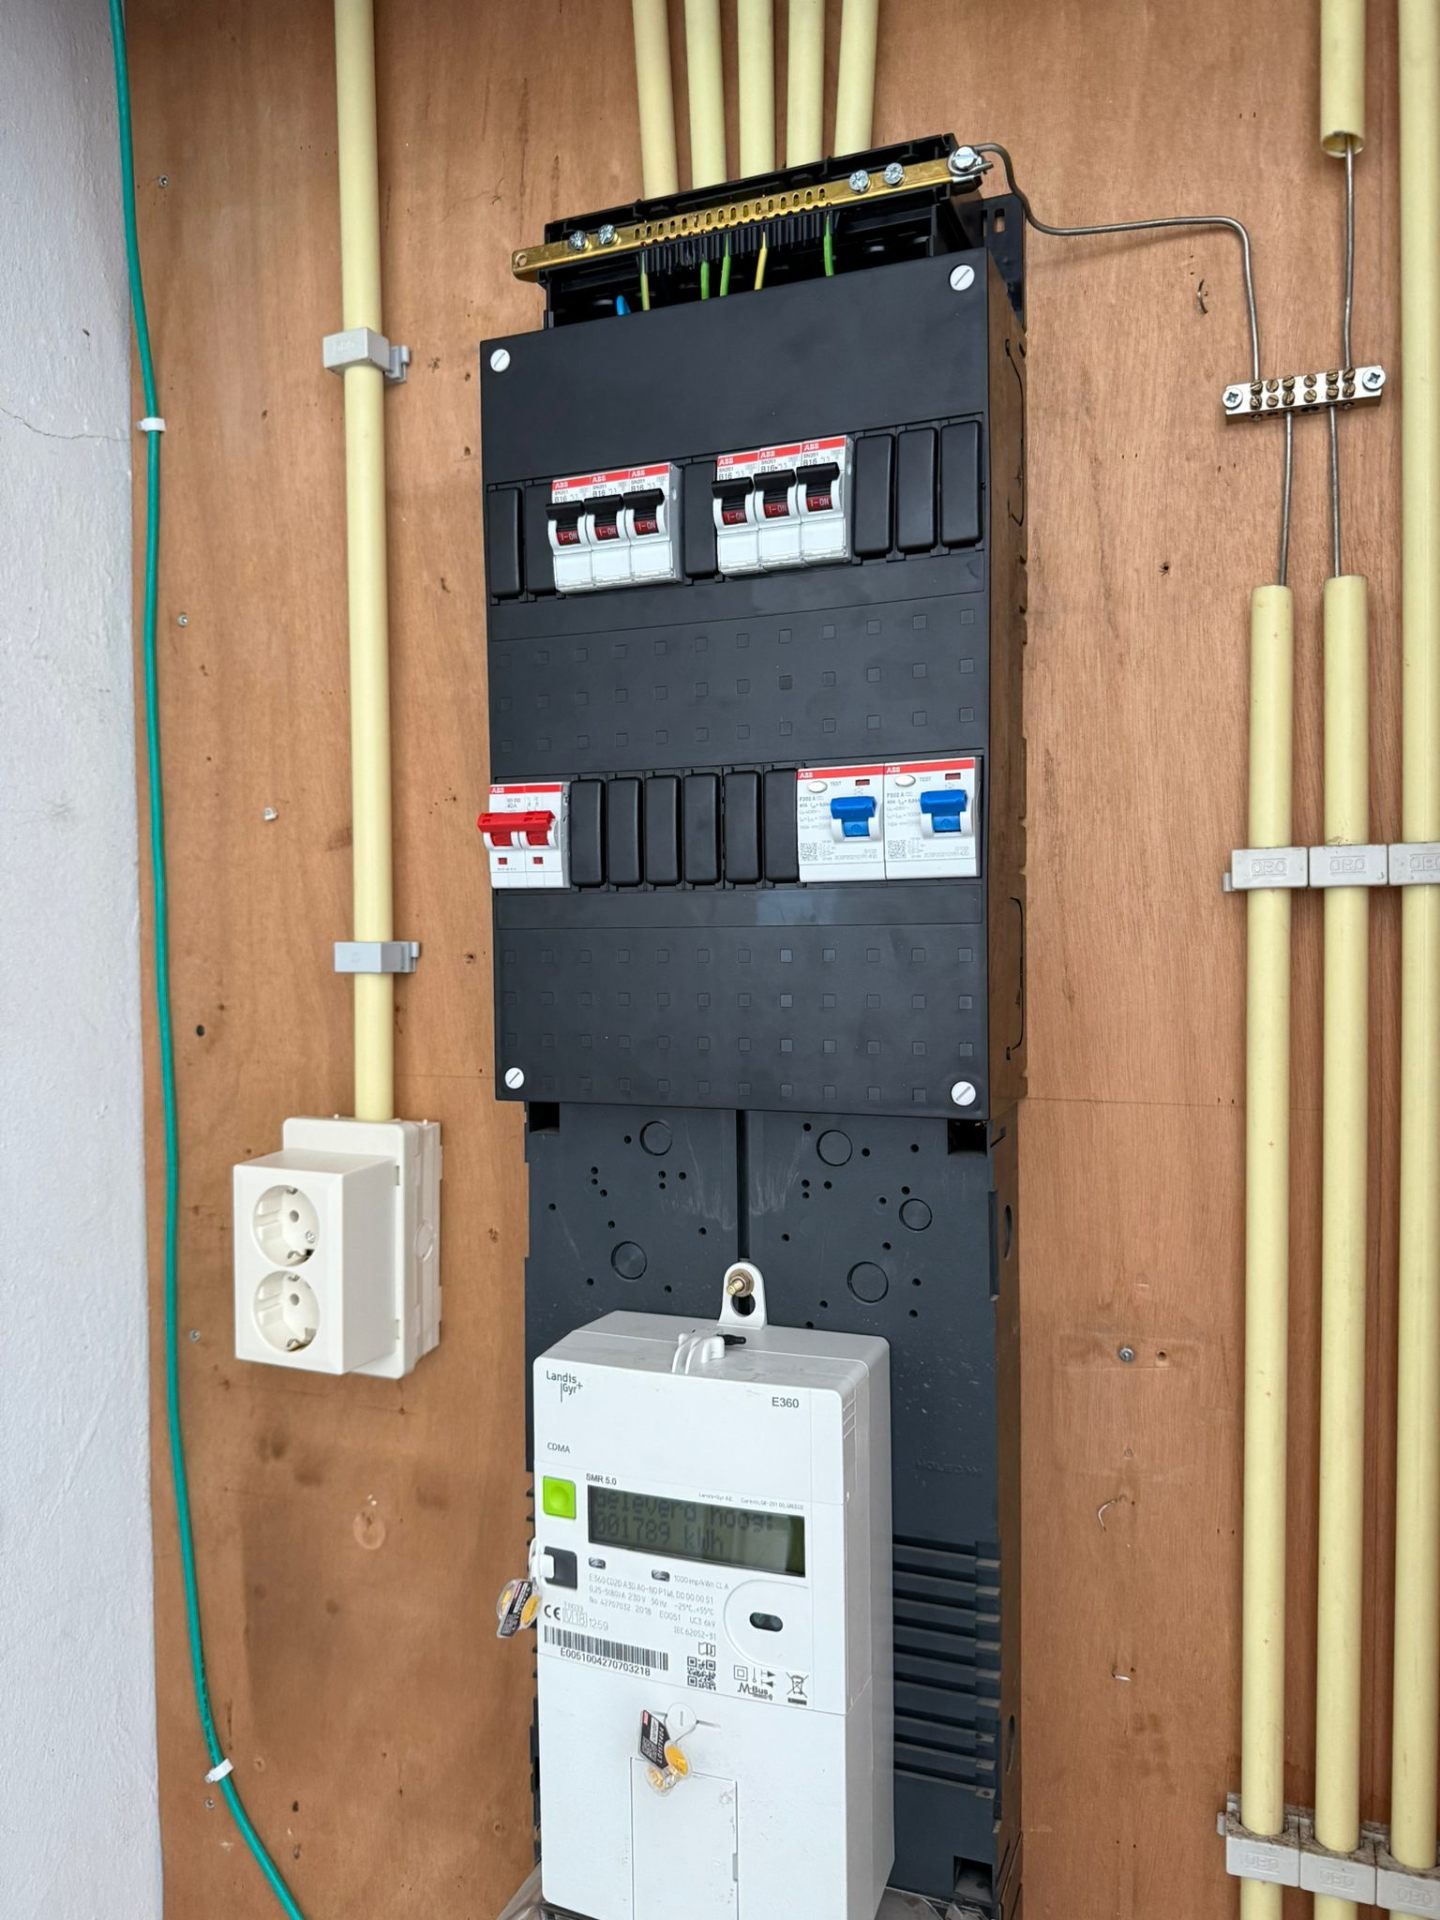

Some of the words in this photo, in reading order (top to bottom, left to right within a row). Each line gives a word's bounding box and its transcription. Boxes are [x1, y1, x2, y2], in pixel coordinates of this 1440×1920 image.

[804, 442, 819, 451] ABB
[761, 450, 776, 458] ABB
[719, 457, 734, 466] ABB
[631, 469, 646, 478] ABB
[592, 475, 606, 483] ABB
[554, 481, 569, 489] ABB
[800, 771, 814, 779] ABB
[887, 766, 901, 775] ABB
[546, 1370, 577, 1385] Landis
[771, 1396, 800, 1409] E360
[547, 1442, 571, 1454] CDMA
[586, 1473, 604, 1484] SMR
[606, 1476, 617, 1486] 5.0
[560, 1647, 651, 1677] E0051004270703218
